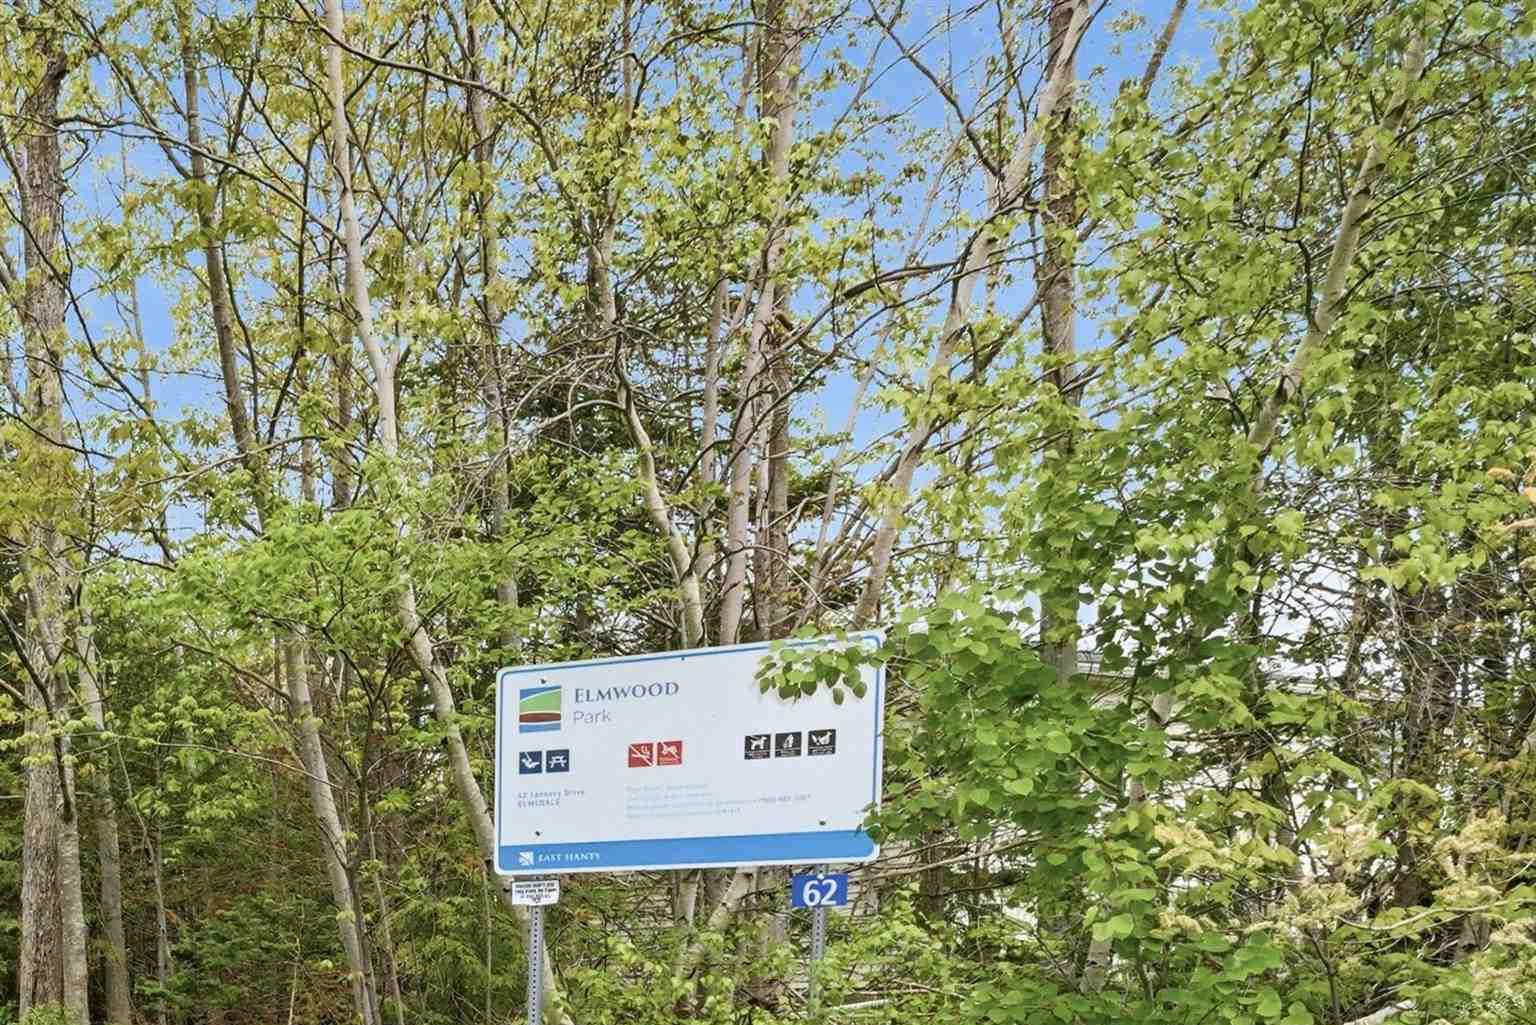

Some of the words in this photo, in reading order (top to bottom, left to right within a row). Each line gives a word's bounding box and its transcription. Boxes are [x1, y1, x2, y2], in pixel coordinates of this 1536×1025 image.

[574, 682, 680, 704] ELMWOOD
[572, 708, 612, 725] Park
[538, 853, 562, 863] EAST
[802, 879, 838, 906] 62
